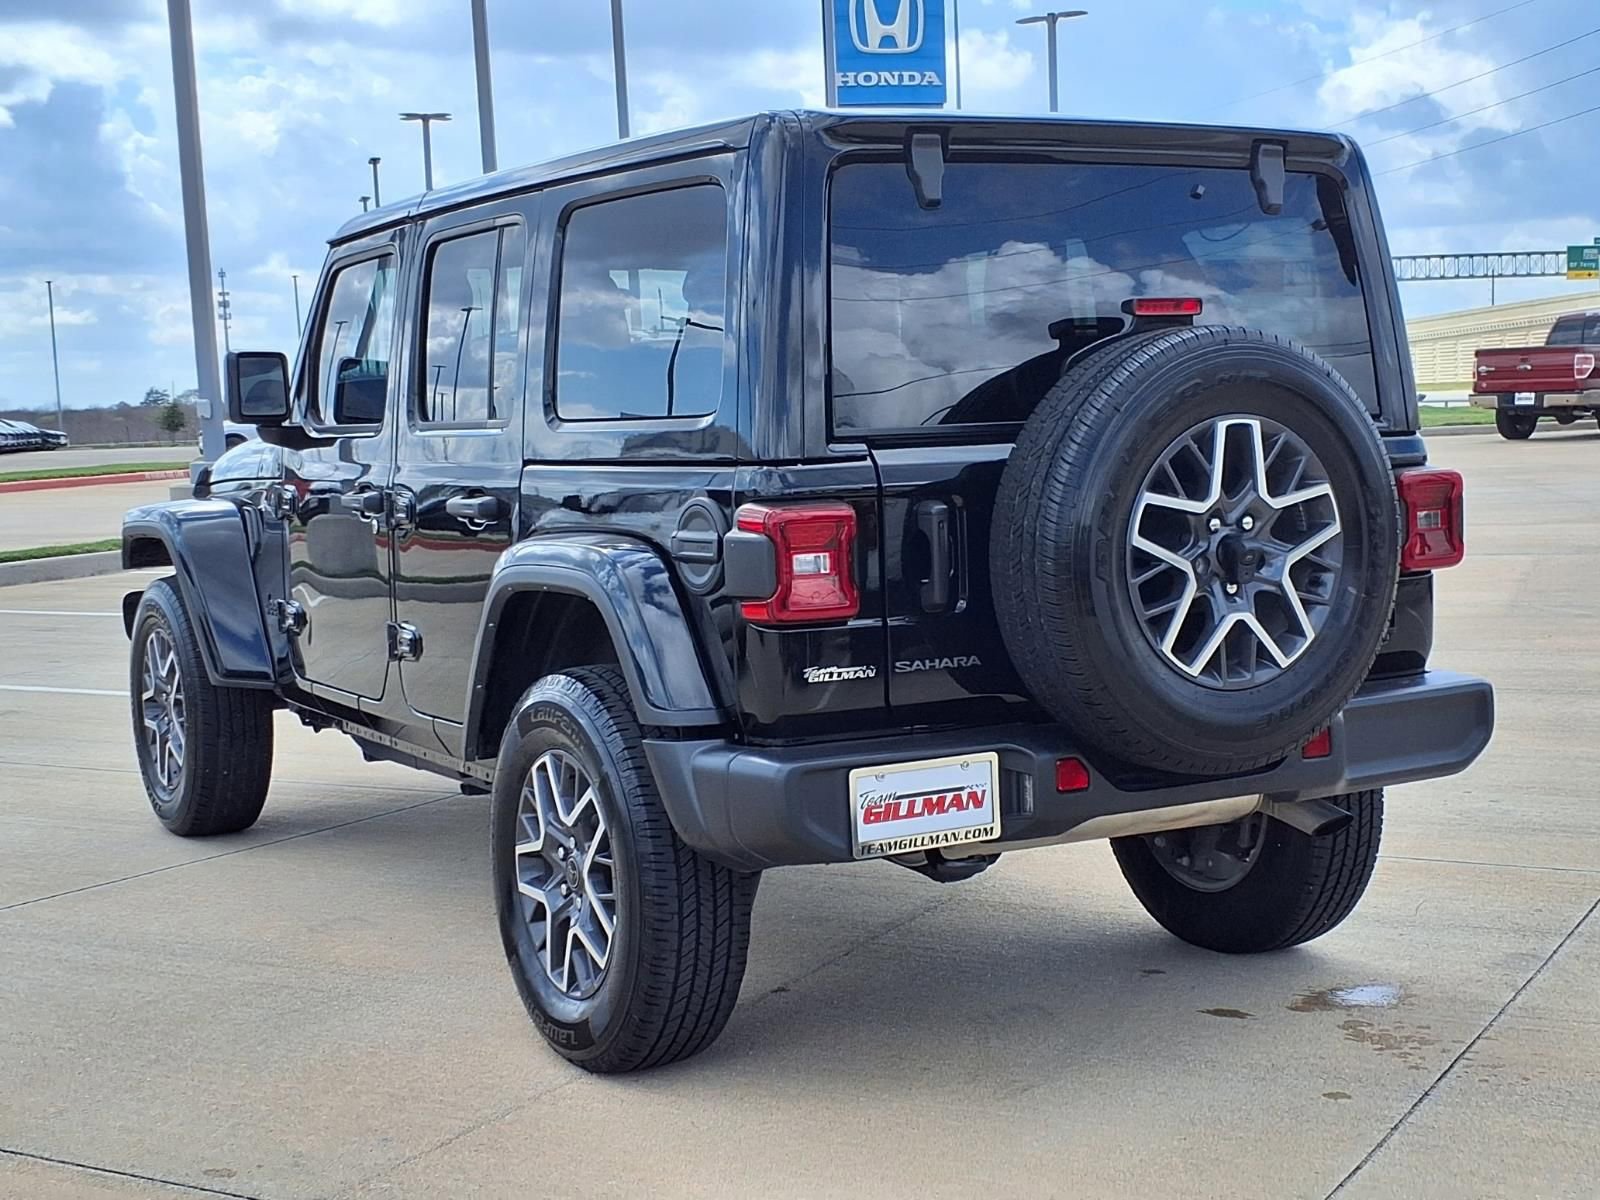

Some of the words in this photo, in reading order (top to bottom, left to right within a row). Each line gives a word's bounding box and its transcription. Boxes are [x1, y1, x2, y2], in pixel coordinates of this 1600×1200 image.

[835, 71, 943, 87] HONDA
[895, 655, 981, 673] SAHARA
[808, 668, 877, 683] GILLMAN
[859, 789, 897, 810] Team
[863, 789, 987, 826] GILLMAN
[859, 826, 995, 857] TEAMGILLMAN.COM
